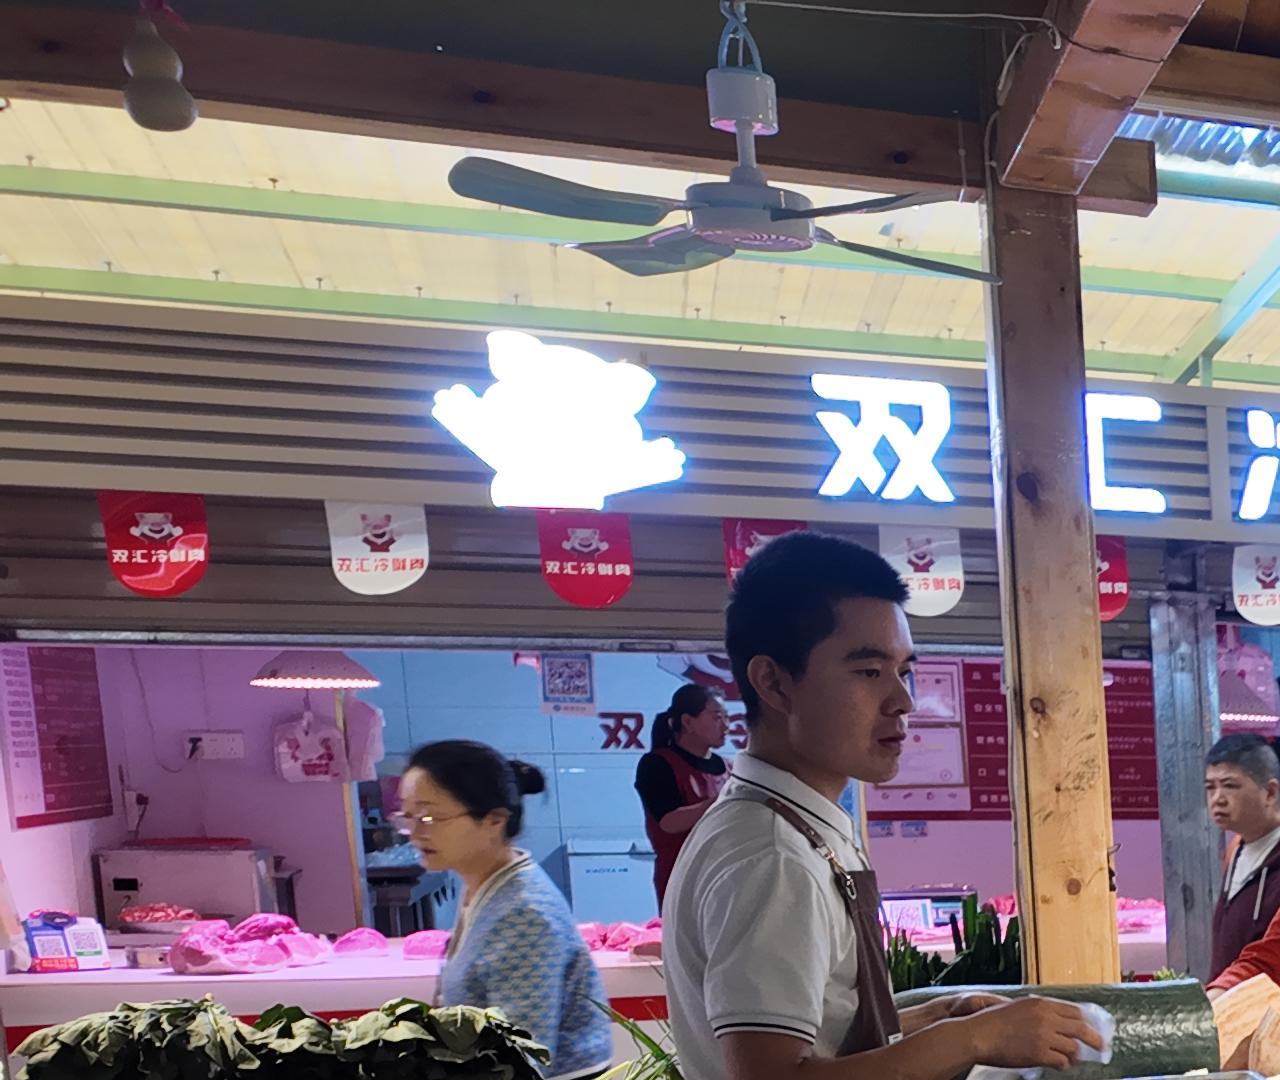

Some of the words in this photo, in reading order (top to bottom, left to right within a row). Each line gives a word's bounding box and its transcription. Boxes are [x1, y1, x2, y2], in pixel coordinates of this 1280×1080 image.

[111, 548, 206, 565] 双汇冷鲜肉
[336, 557, 426, 574] 双汇冷鲜肉
[545, 560, 632, 577] 双汇冷鲜肉
